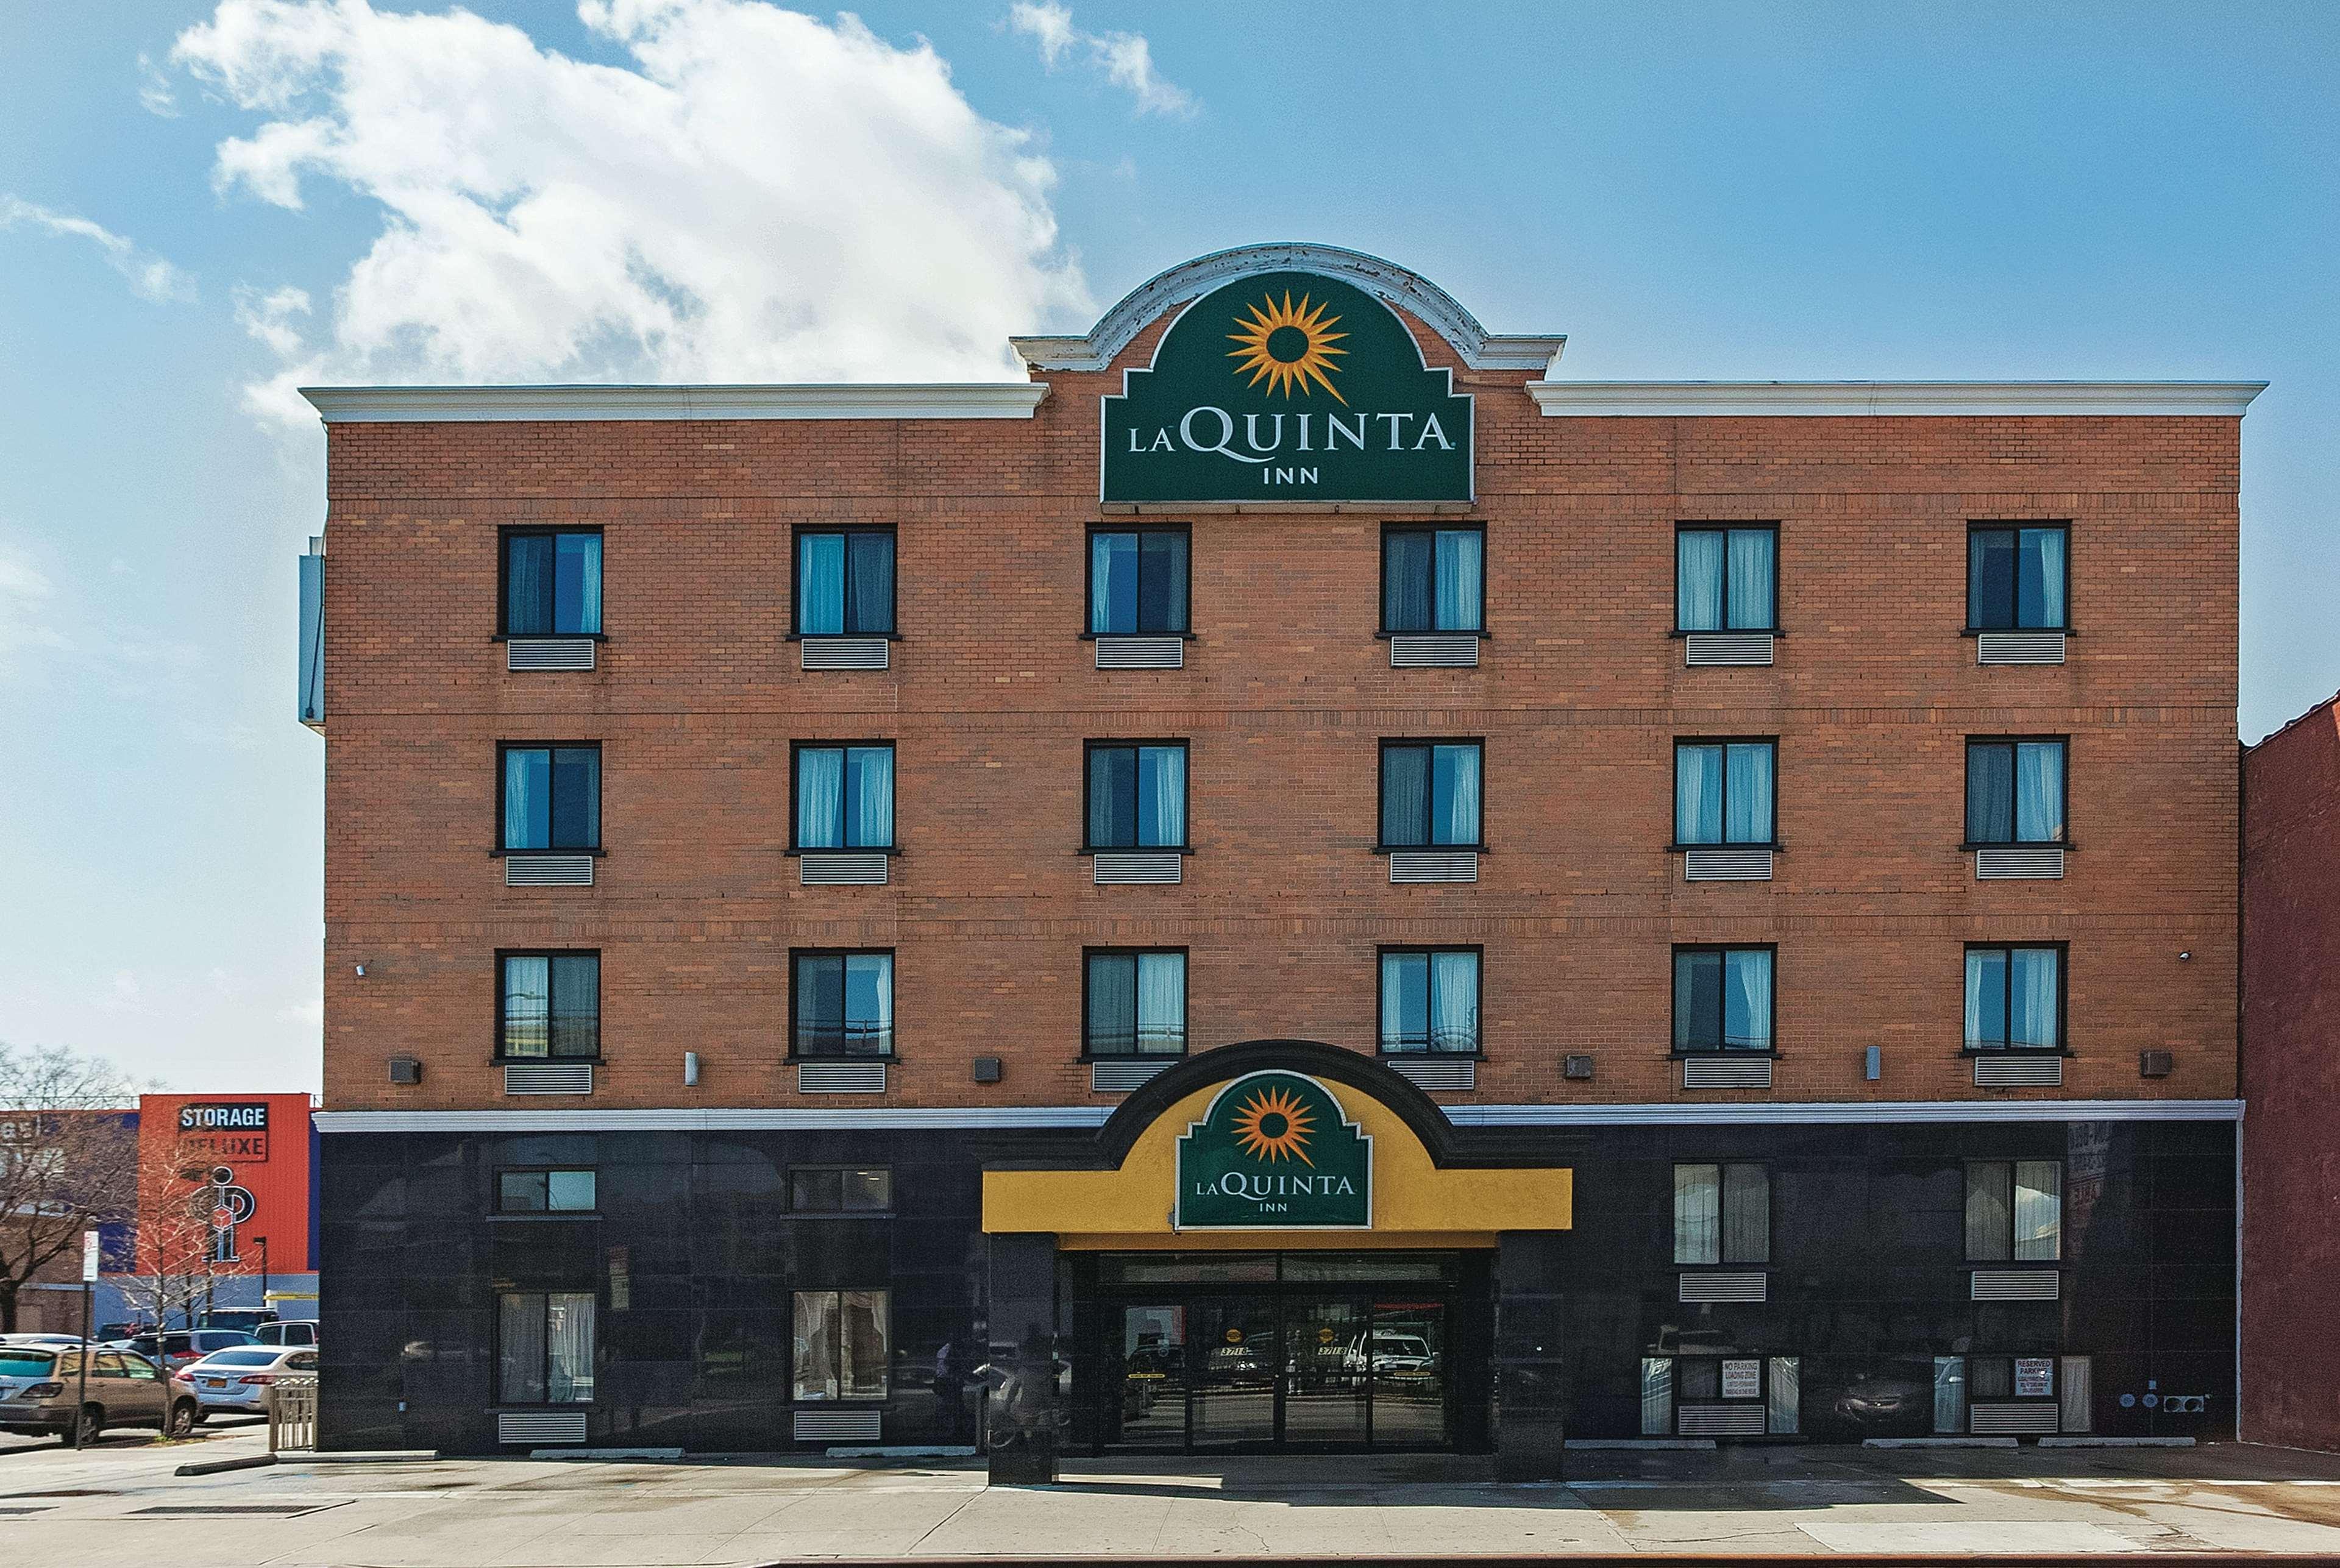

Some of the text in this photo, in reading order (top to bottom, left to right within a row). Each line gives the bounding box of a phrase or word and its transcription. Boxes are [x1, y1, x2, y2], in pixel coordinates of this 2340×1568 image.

[1128, 406, 1455, 463] LA QUINTA
[1264, 467, 1318, 484] INN
[182, 1109, 265, 1126] STORAGE
[183, 1138, 263, 1154] ELUXE
[1197, 1172, 1356, 1201] LA QUINTA
[1260, 1203, 1287, 1212] INN
